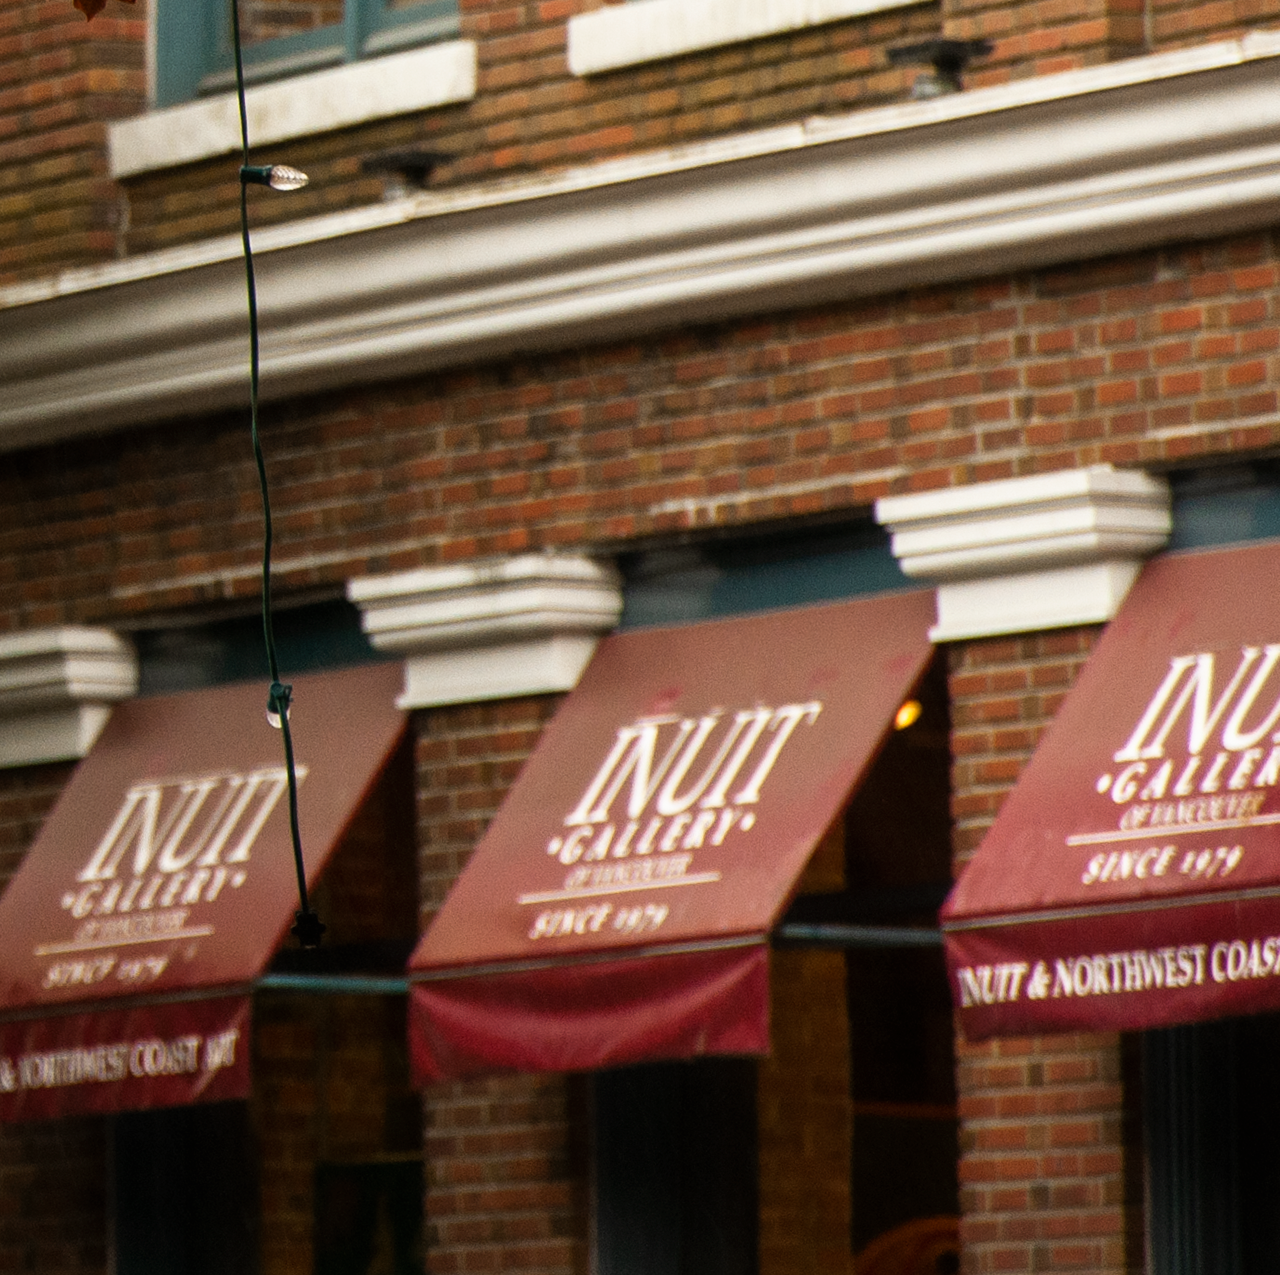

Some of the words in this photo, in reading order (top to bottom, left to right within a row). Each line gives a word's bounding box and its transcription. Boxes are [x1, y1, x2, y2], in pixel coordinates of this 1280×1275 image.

[1113, 644, 1280, 762] INU
[564, 700, 823, 826] INUIT
[77, 764, 310, 882] INUIT
[1081, 845, 1177, 885] SINCE
[1026, 959, 1052, 1001] &
[1052, 943, 1208, 999] NORTHWEST
[1210, 935, 1280, 984] COAS
